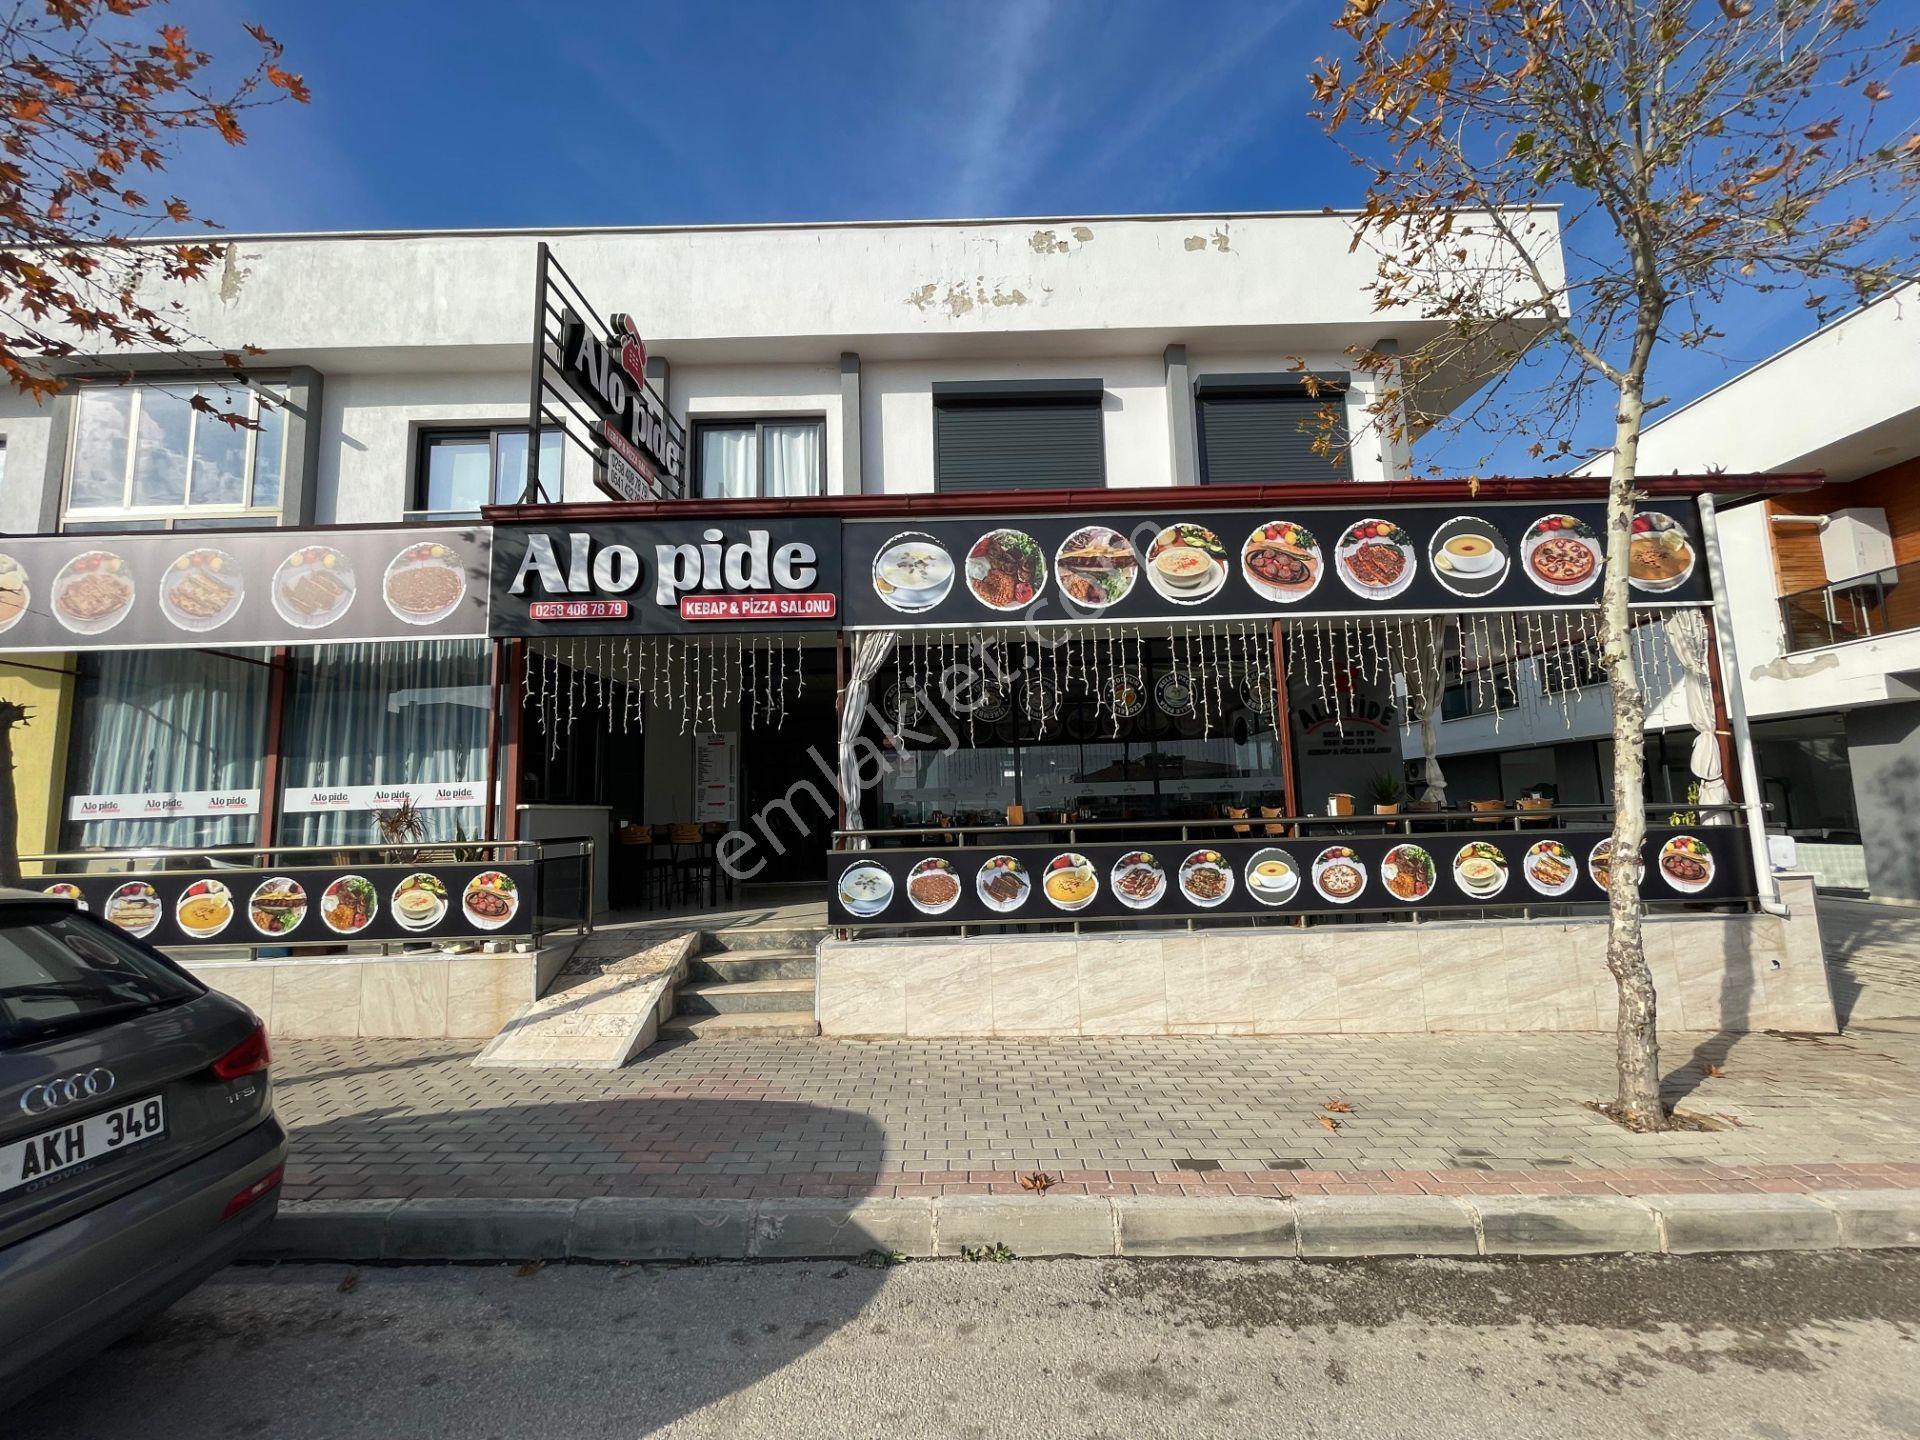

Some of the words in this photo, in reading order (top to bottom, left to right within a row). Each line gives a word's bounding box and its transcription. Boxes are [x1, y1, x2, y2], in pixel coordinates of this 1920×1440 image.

[574, 331, 625, 415] Alo
[631, 398, 680, 476] pide
[507, 532, 640, 594] Alo
[655, 528, 818, 606] pide
[536, 604, 565, 616] 0258
[567, 604, 588, 616] 408
[591, 603, 605, 616] 78
[608, 603, 622, 616] 79
[686, 601, 728, 615] KEBAP
[730, 602, 740, 614] &
[742, 597, 778, 614] PİZZA
[780, 599, 830, 614] SALONU
[312, 793, 327, 802] Alo
[328, 792, 348, 802] pide
[374, 791, 390, 799] Alo
[390, 790, 410, 800] pide
[436, 789, 452, 797] Alo
[452, 788, 472, 798] pide
[145, 800, 160, 808] Alo
[162, 798, 182, 808] pide
[208, 797, 225, 806] Alo
[226, 796, 246, 806] pide
[82, 802, 97, 810] Alo
[98, 802, 118, 812] pide
[21, 1124, 86, 1180] AKH
[106, 1100, 160, 1147] 348
